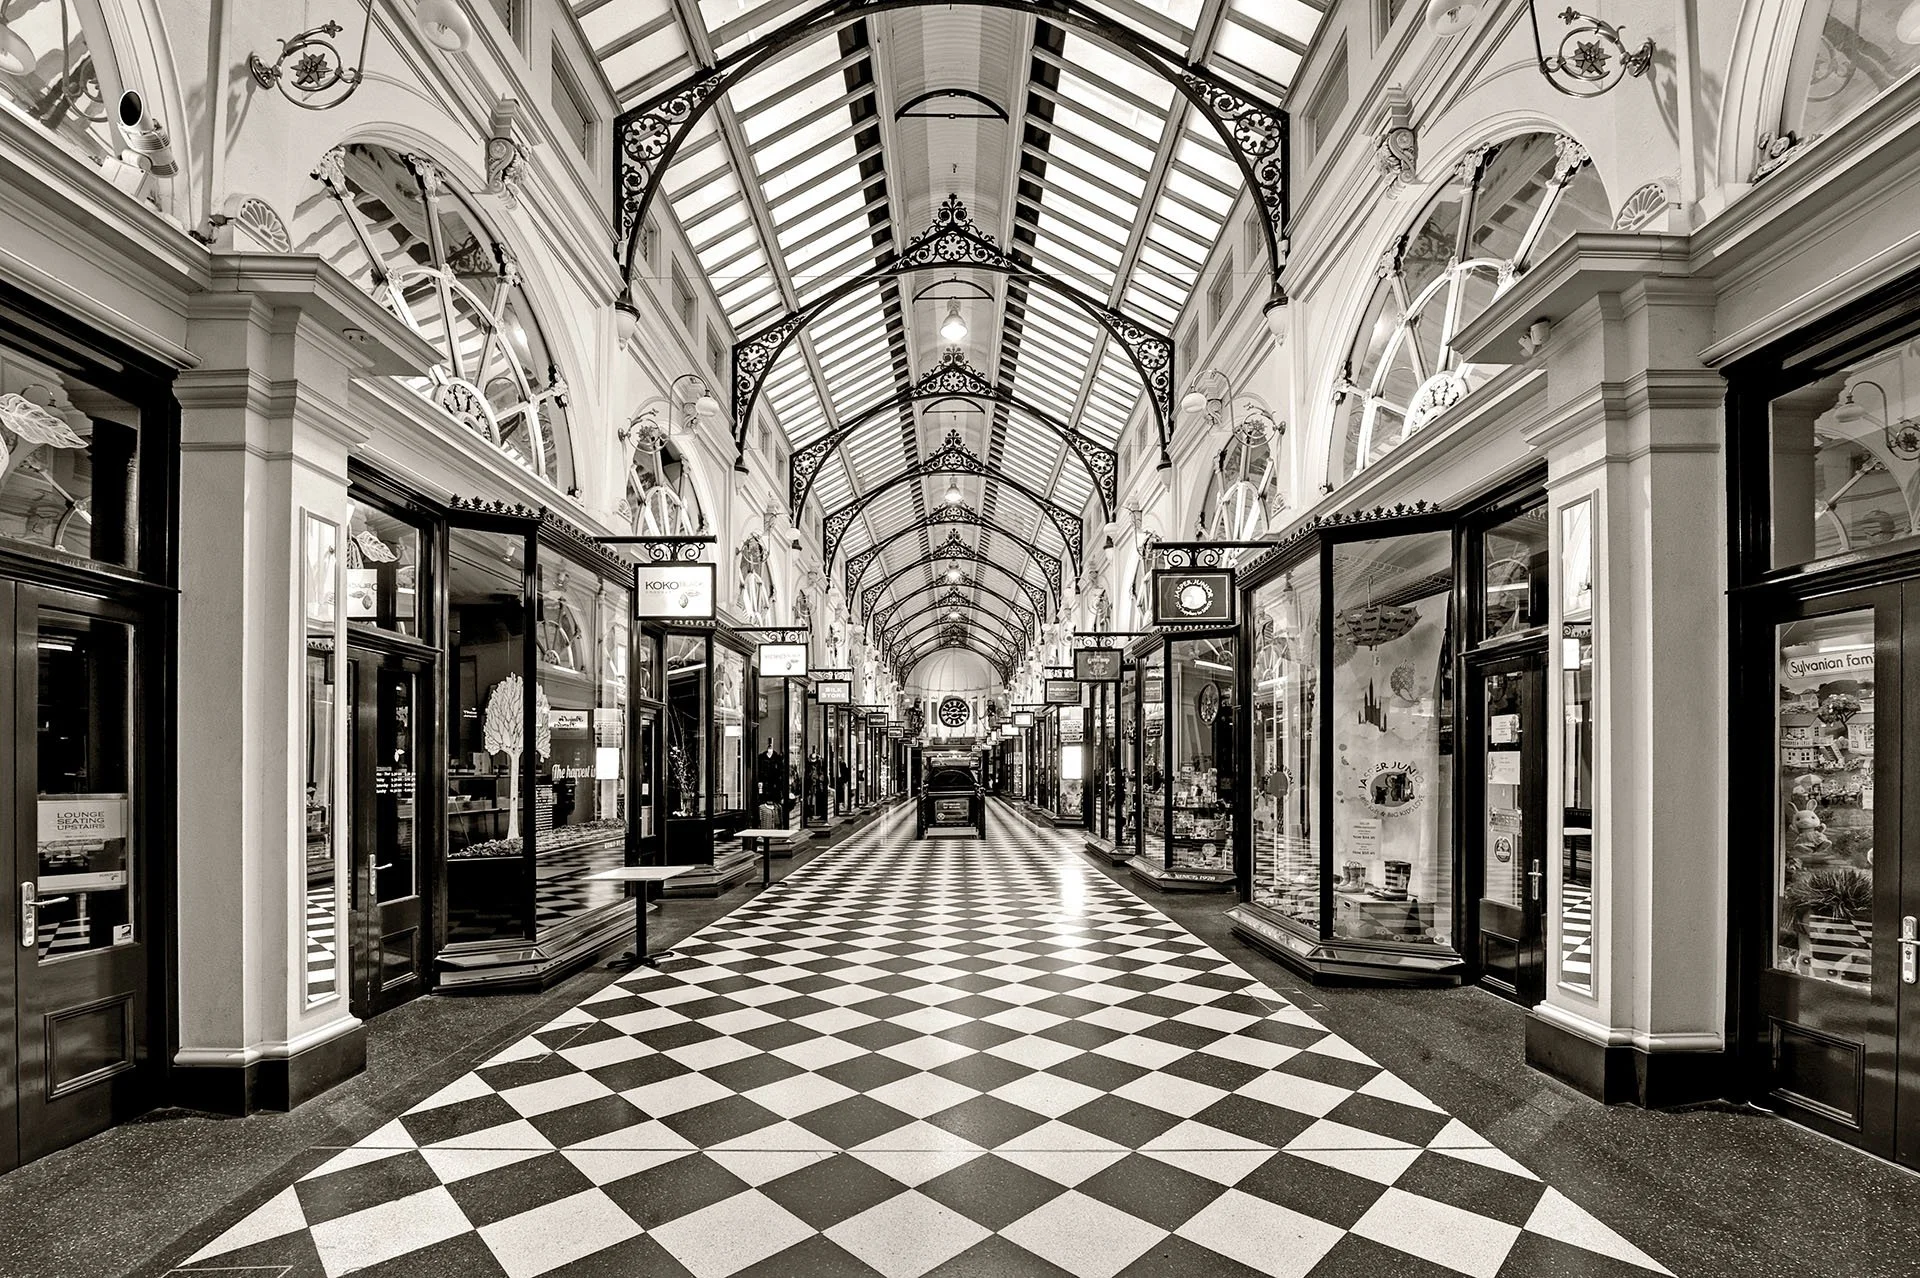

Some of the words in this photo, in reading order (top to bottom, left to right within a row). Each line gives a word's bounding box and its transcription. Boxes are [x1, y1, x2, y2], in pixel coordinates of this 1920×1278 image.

[645, 581, 679, 590] KOKO
[1174, 579, 1192, 598] JASPER
[1193, 579, 1214, 598] JUNIOR
[1790, 657, 1843, 676] Sylvanian
[552, 764, 566, 780] The
[1358, 762, 1389, 790] JASPER
[57, 811, 105, 819] LOUNGE
[1400, 808, 1415, 816] KIDS
